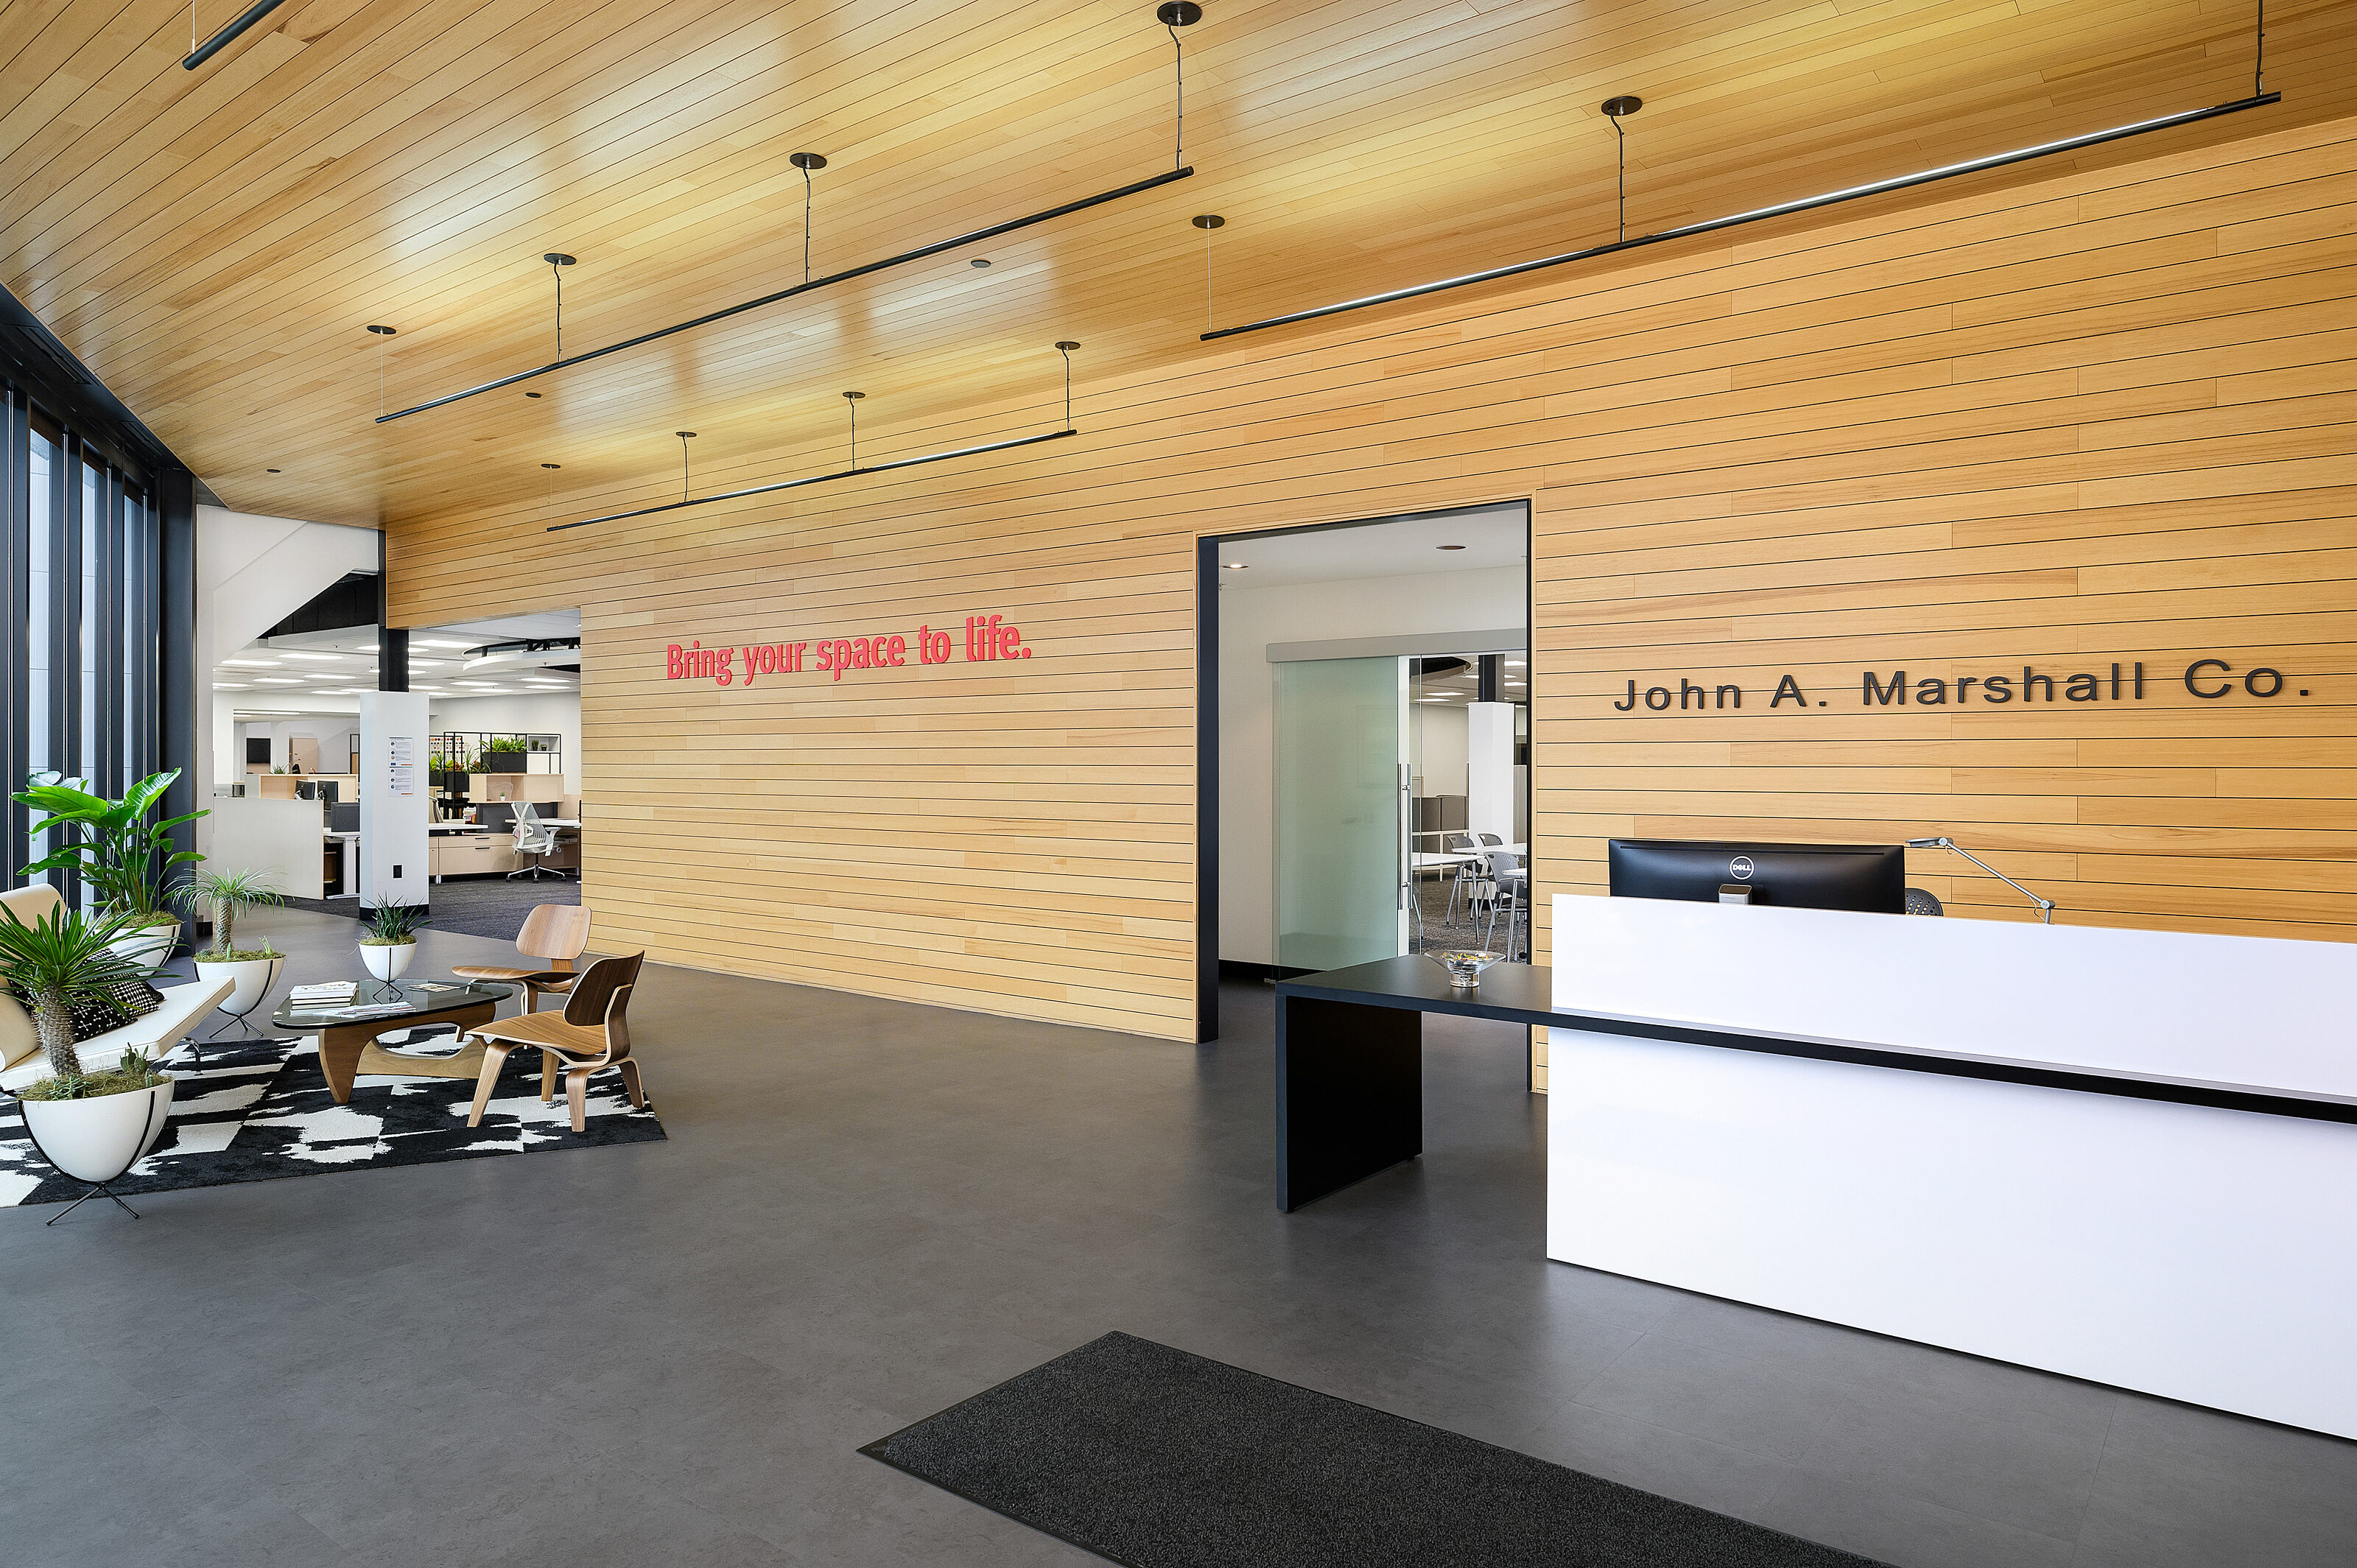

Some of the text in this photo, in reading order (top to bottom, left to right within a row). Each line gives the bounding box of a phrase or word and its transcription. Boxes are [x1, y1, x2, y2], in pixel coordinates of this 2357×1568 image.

[667, 614, 1032, 686] Bring your space to life.
[1614, 658, 2309, 711] John A. Marshall Co.
